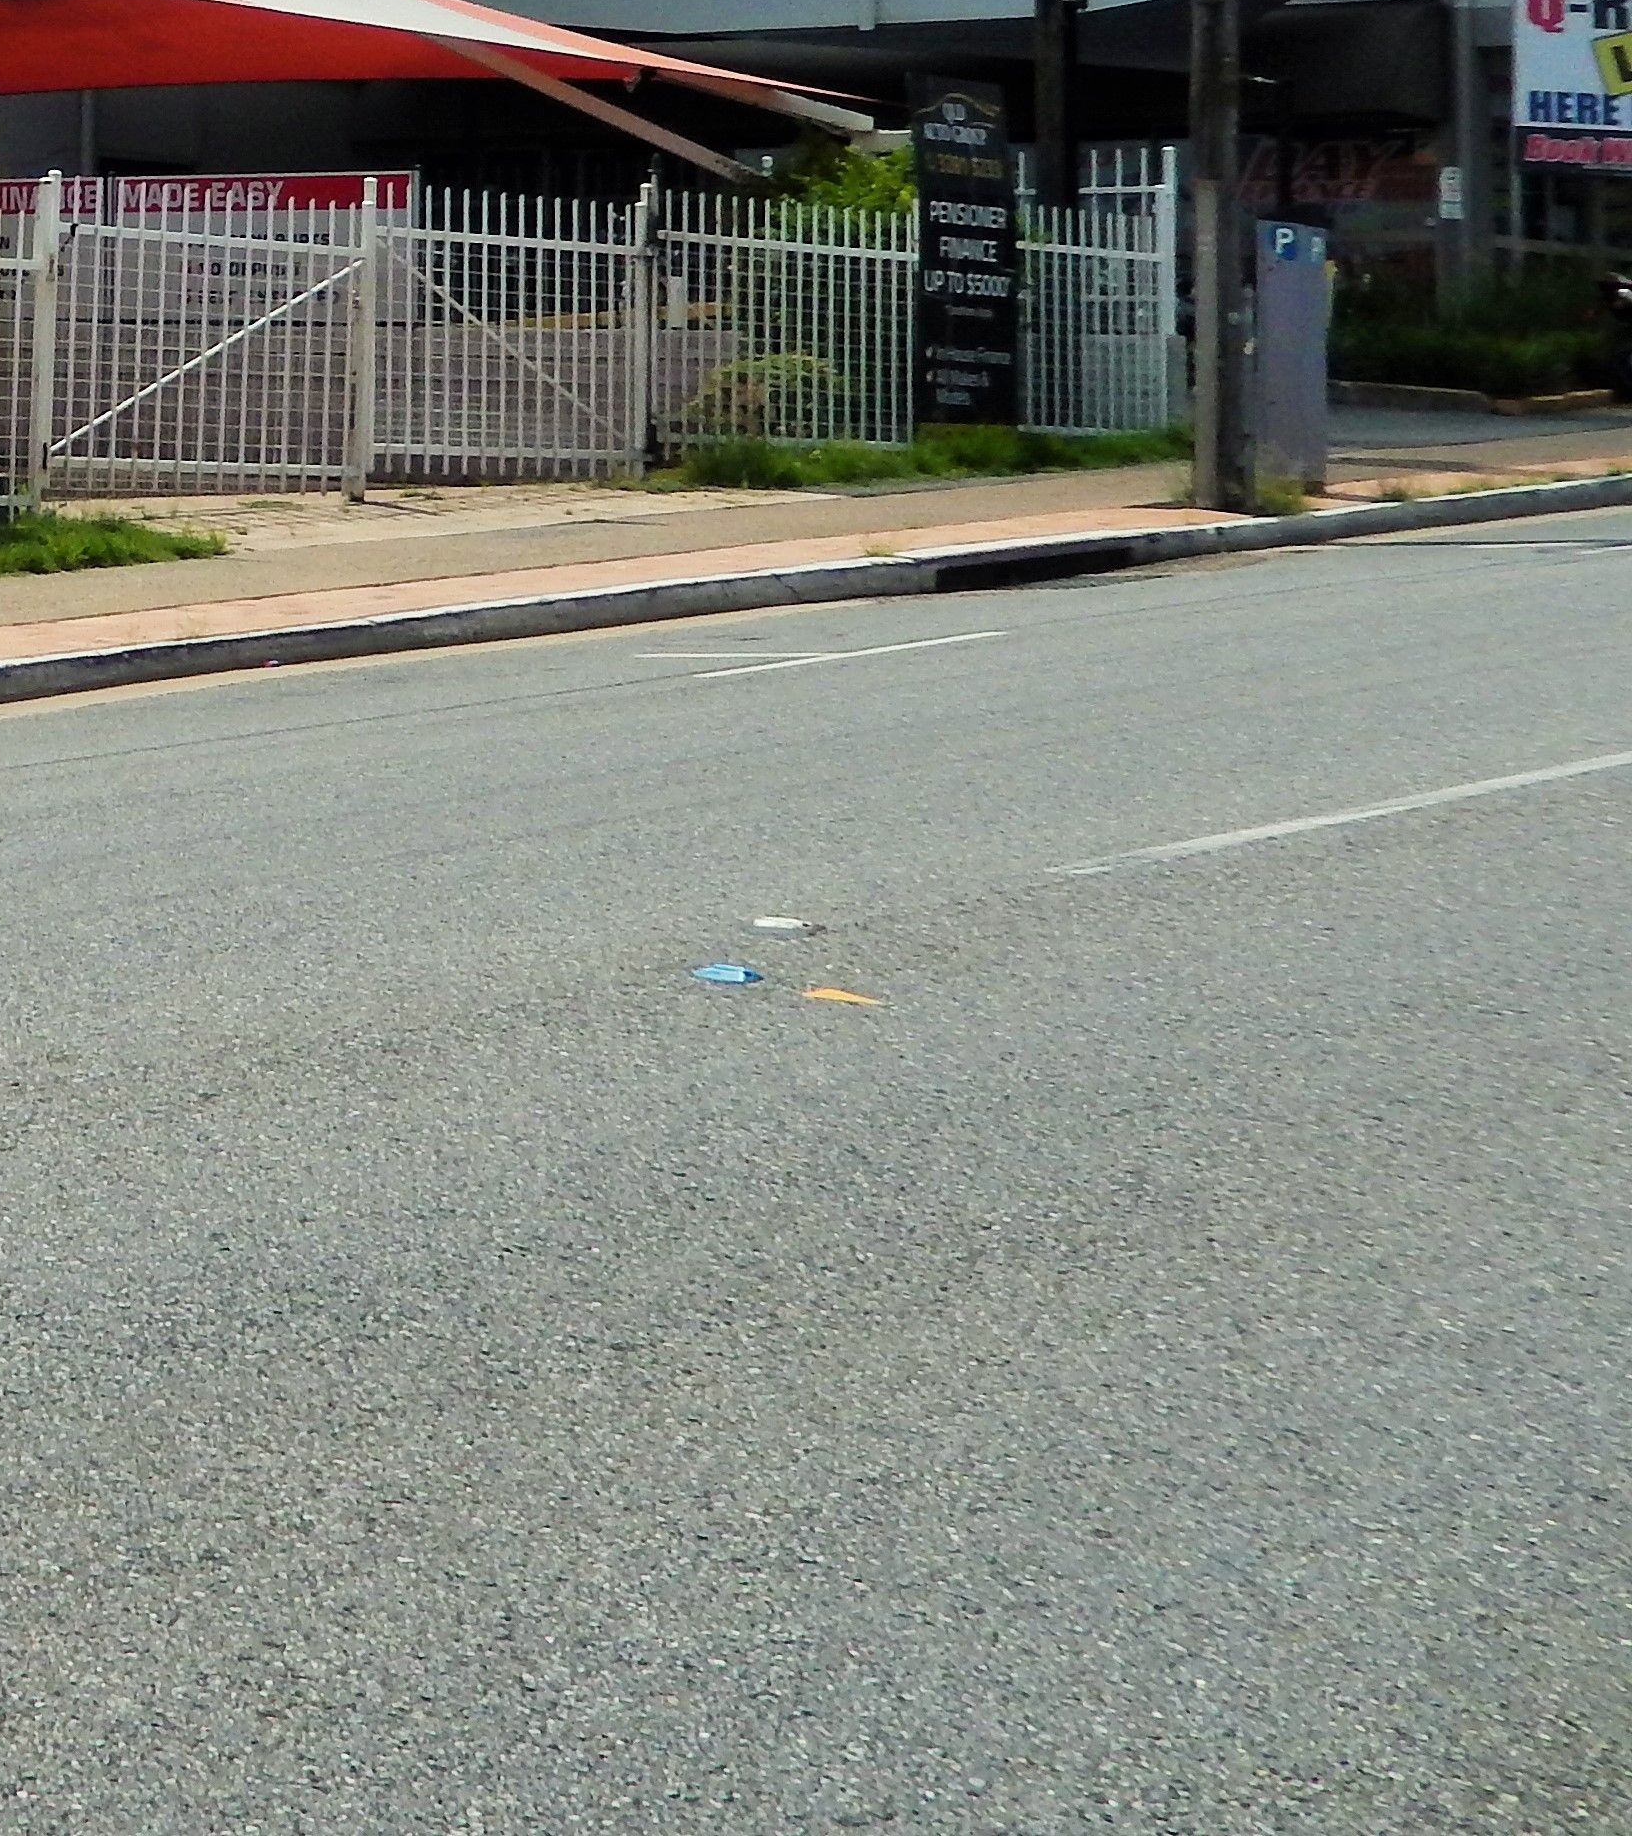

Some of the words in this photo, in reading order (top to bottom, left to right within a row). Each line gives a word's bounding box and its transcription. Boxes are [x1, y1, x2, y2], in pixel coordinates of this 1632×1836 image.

[1528, 89, 1622, 126] HERE
[122, 182, 200, 210] MADE
[210, 179, 285, 208] EASY
[1274, 227, 1295, 255] P
